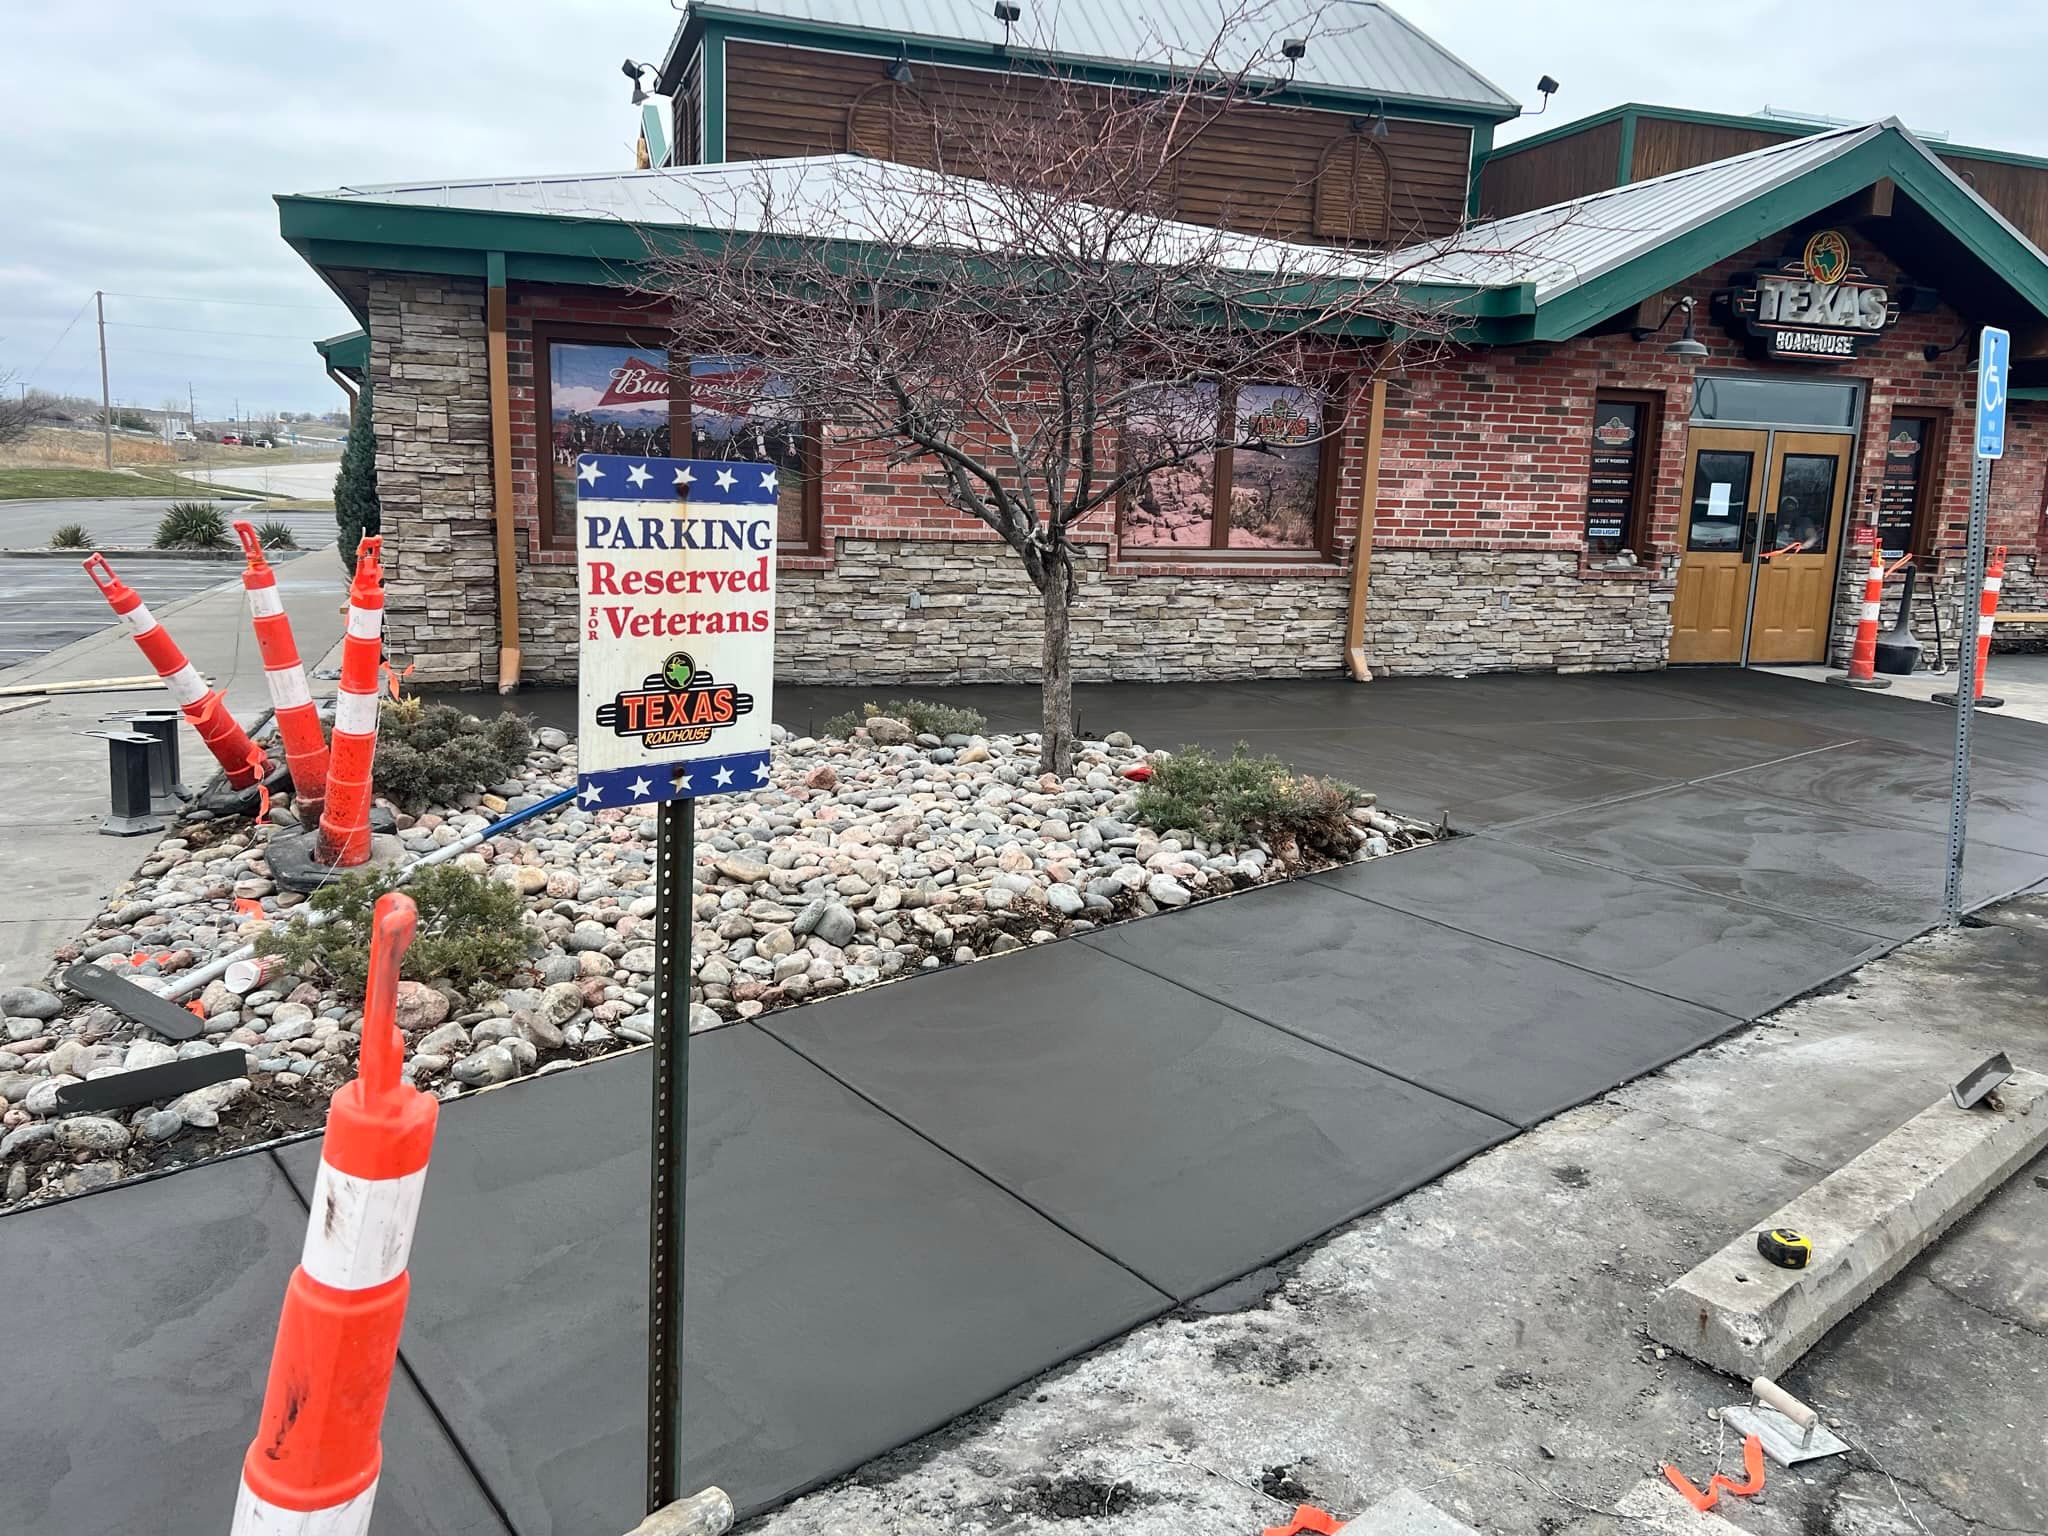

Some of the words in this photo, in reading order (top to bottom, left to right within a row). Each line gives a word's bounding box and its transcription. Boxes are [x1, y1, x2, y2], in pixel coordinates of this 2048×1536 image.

[1757, 279, 1888, 330] TEXAS
[1776, 331, 1855, 354] ROADHOUSE
[585, 516, 772, 550] PARKING
[587, 556, 770, 595] Reserved
[589, 607, 599, 641] FOR
[602, 606, 769, 639] Veterans
[622, 688, 734, 729] TEXAS
[644, 727, 711, 745] ROADHOUSE
